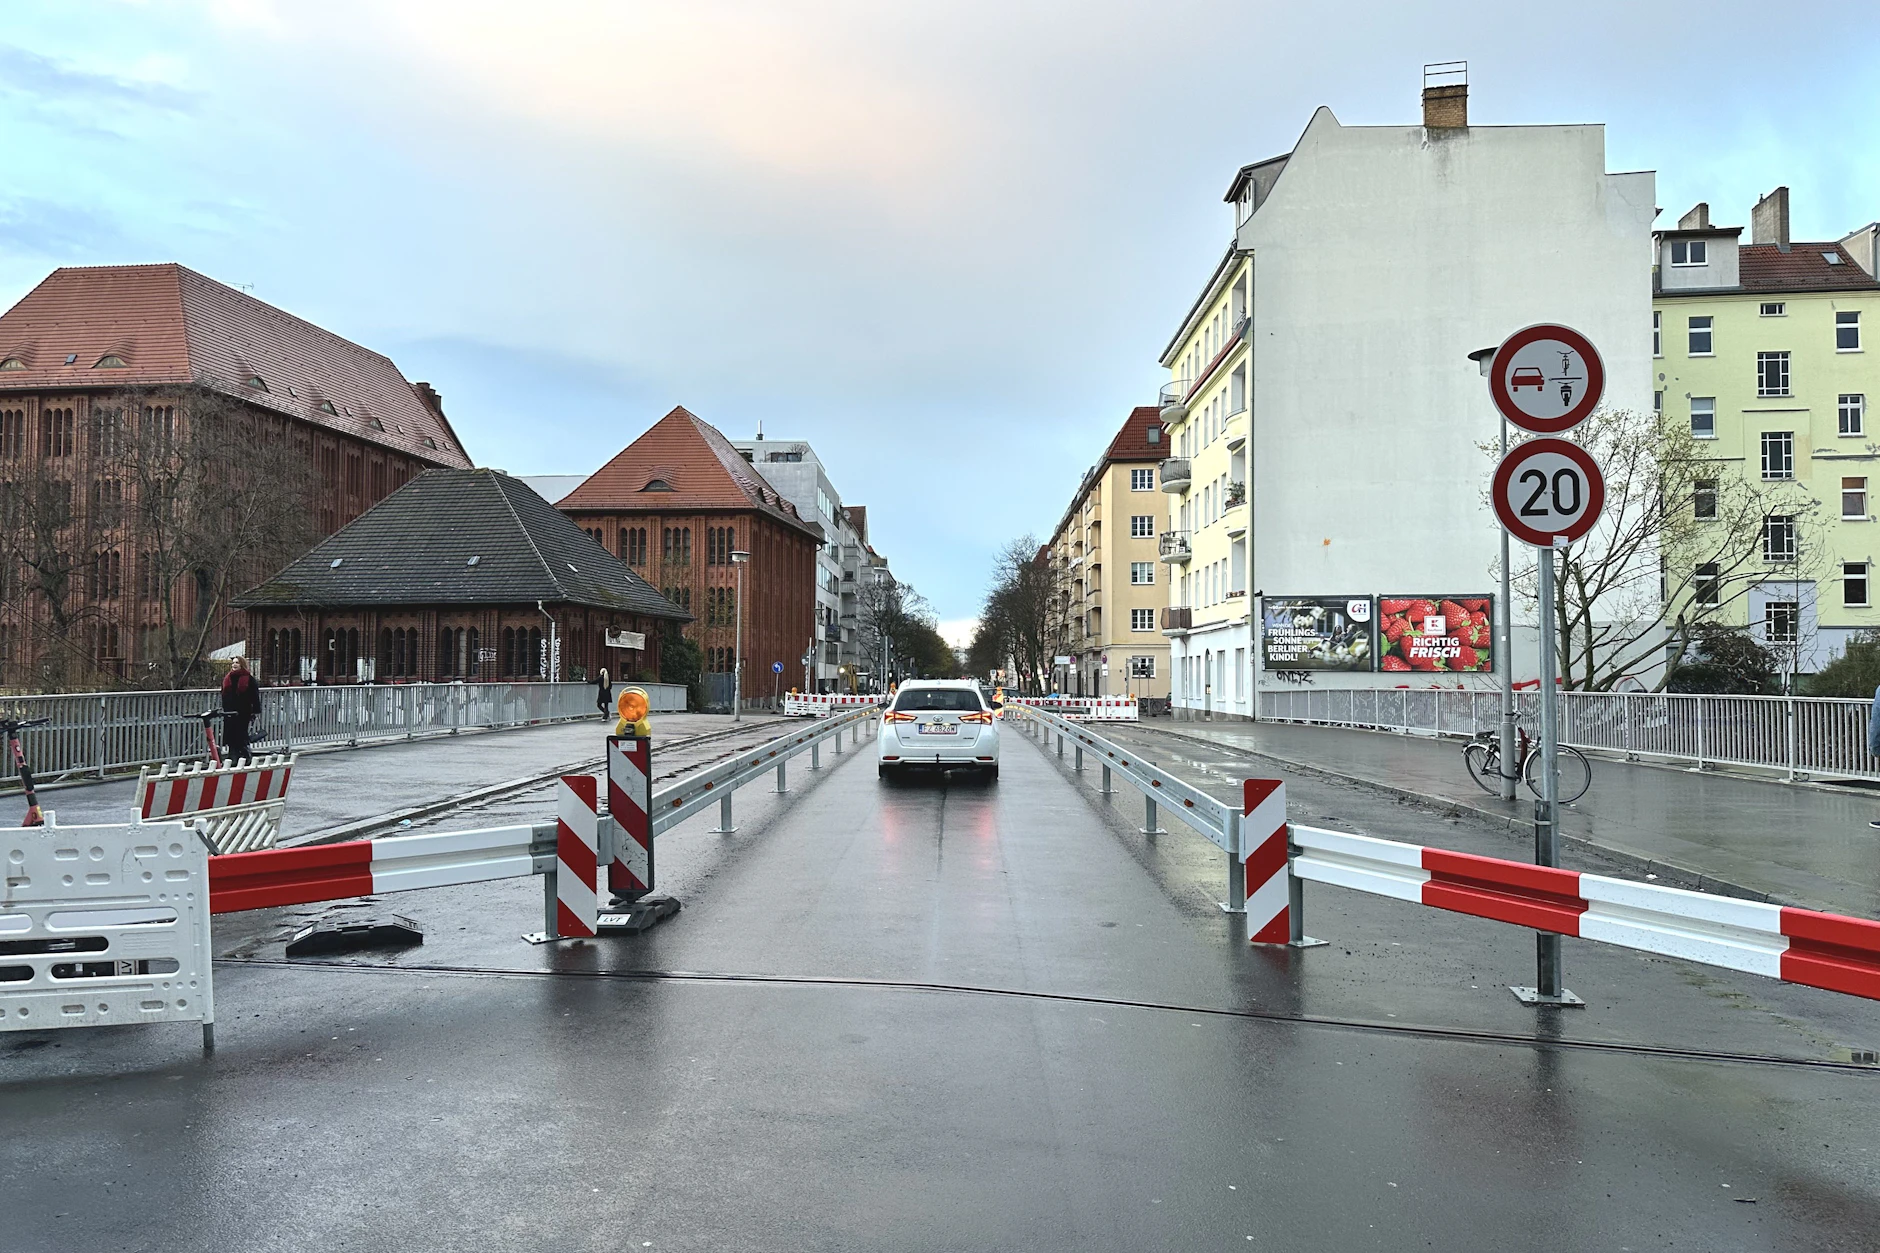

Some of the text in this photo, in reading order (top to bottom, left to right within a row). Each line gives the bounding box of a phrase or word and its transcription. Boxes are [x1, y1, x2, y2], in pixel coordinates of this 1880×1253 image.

[1519, 468, 1581, 517] 20
[1268, 627, 1319, 637] FRÜHLINGS-
[1273, 636, 1302, 645] SONNE
[1412, 637, 1460, 647] RICHTIG
[1267, 644, 1308, 653] BERLINER
[1409, 647, 1461, 658] FRISCH
[1270, 653, 1299, 661] KINDL!
